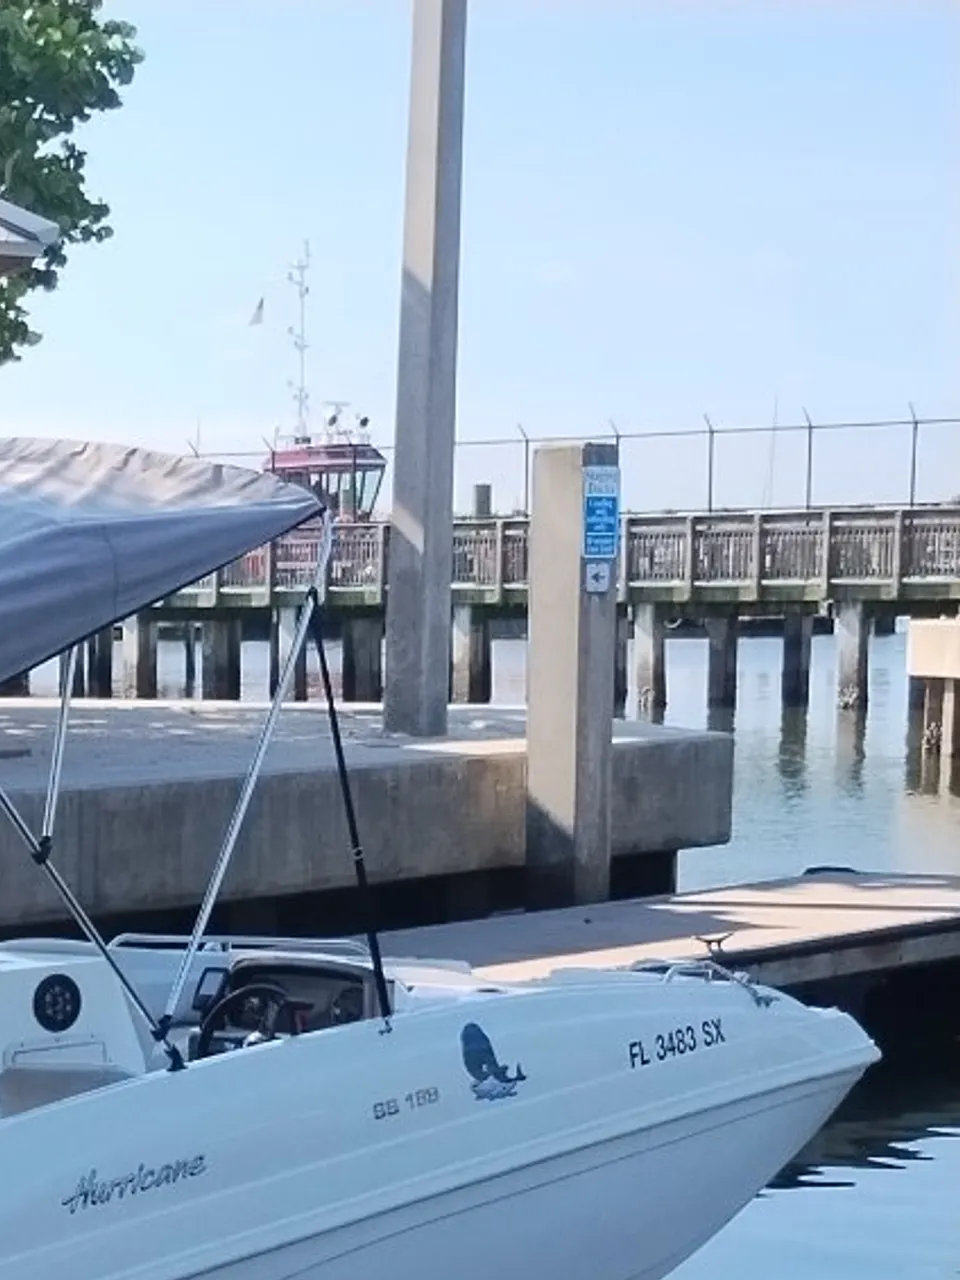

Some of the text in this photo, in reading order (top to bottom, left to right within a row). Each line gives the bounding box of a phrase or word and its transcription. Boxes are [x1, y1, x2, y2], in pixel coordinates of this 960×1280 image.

[629, 1018, 726, 1069] FL 3483 SX
[61, 1154, 207, 1215] Hurricane
